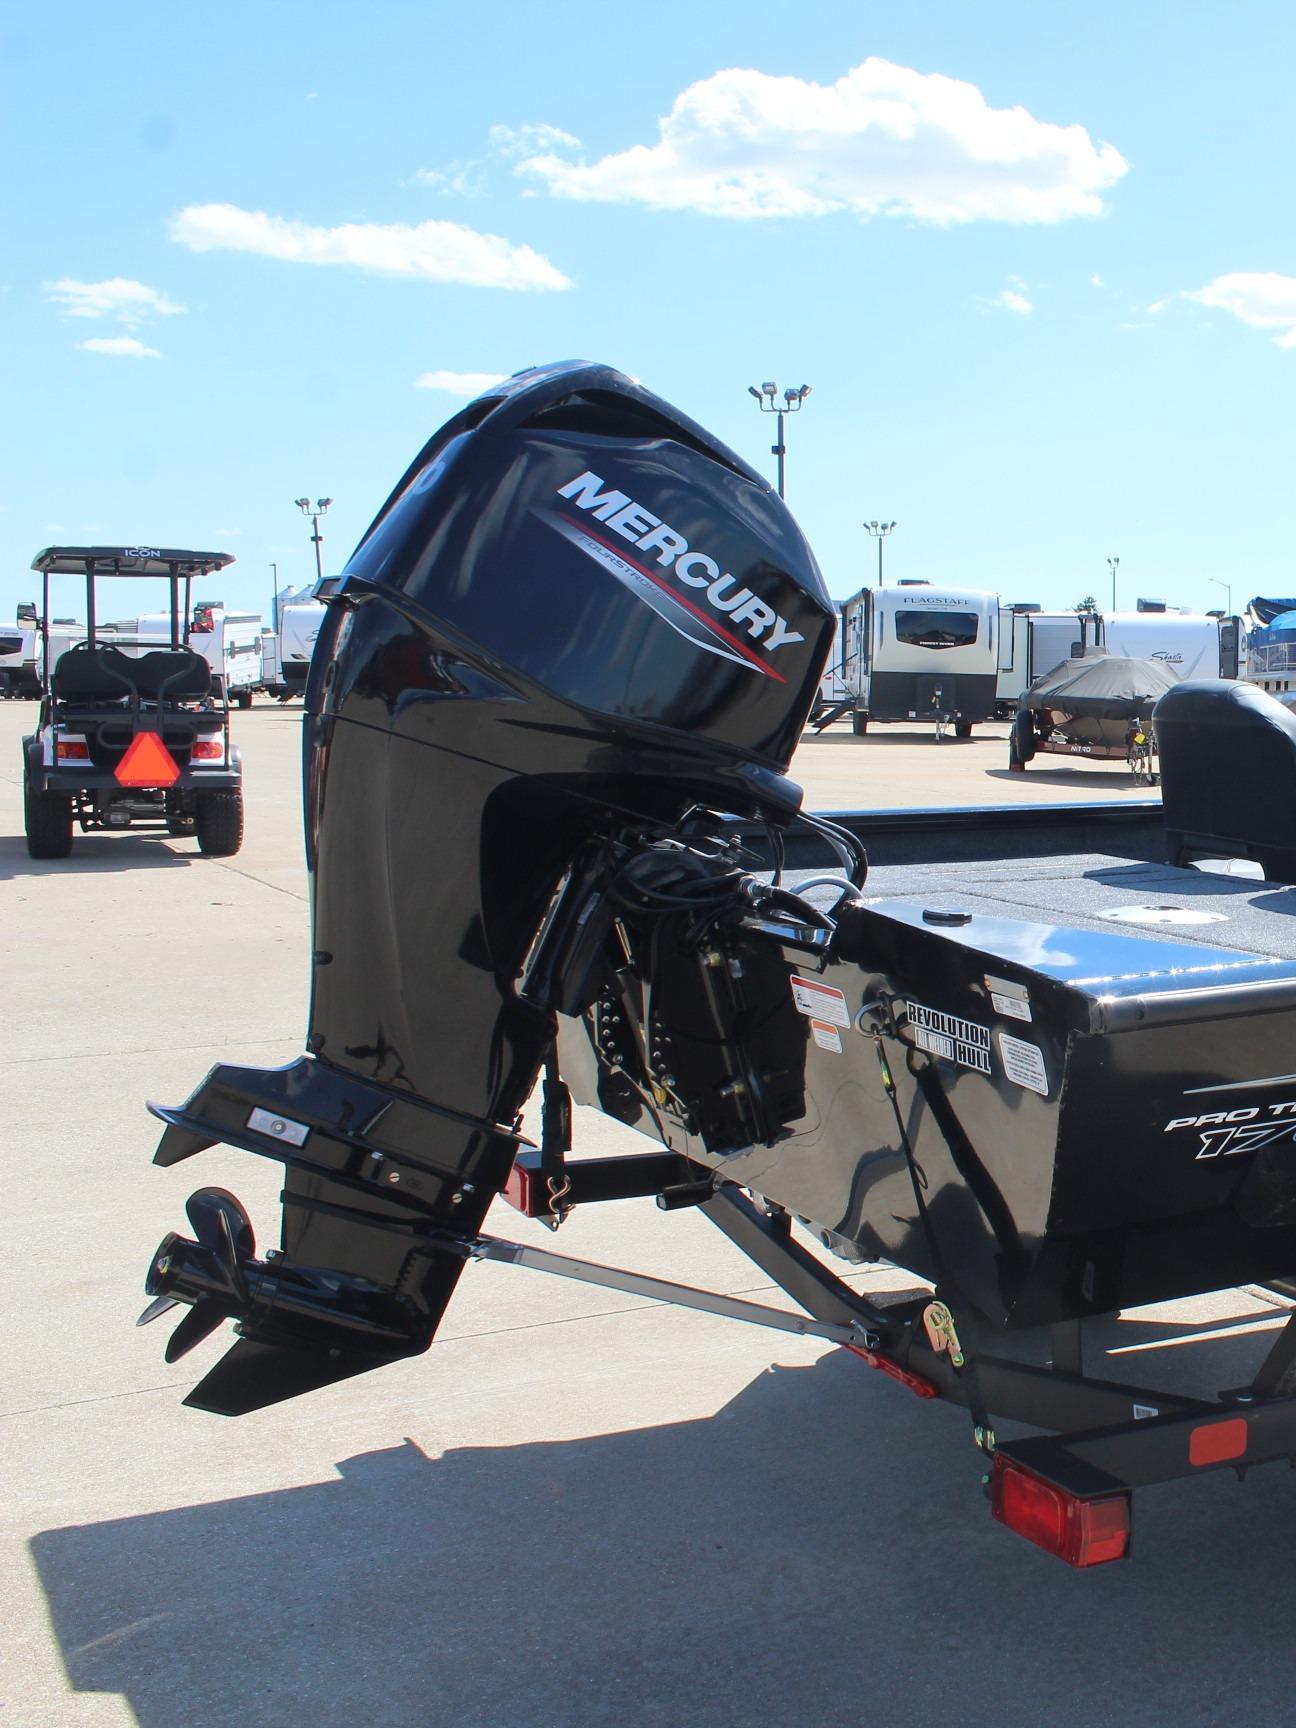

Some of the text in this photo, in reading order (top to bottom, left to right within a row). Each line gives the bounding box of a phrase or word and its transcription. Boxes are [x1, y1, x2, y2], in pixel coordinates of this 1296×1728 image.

[124, 549, 161, 557] ICON
[557, 470, 805, 651] MERCURY
[575, 533, 670, 601] FOURSTROKE
[903, 597, 969, 605] FLAGSTAFF
[908, 1004, 989, 1049] REVOLUTION
[957, 1043, 991, 1073] HULL
[1164, 1107, 1260, 1132] PRO
